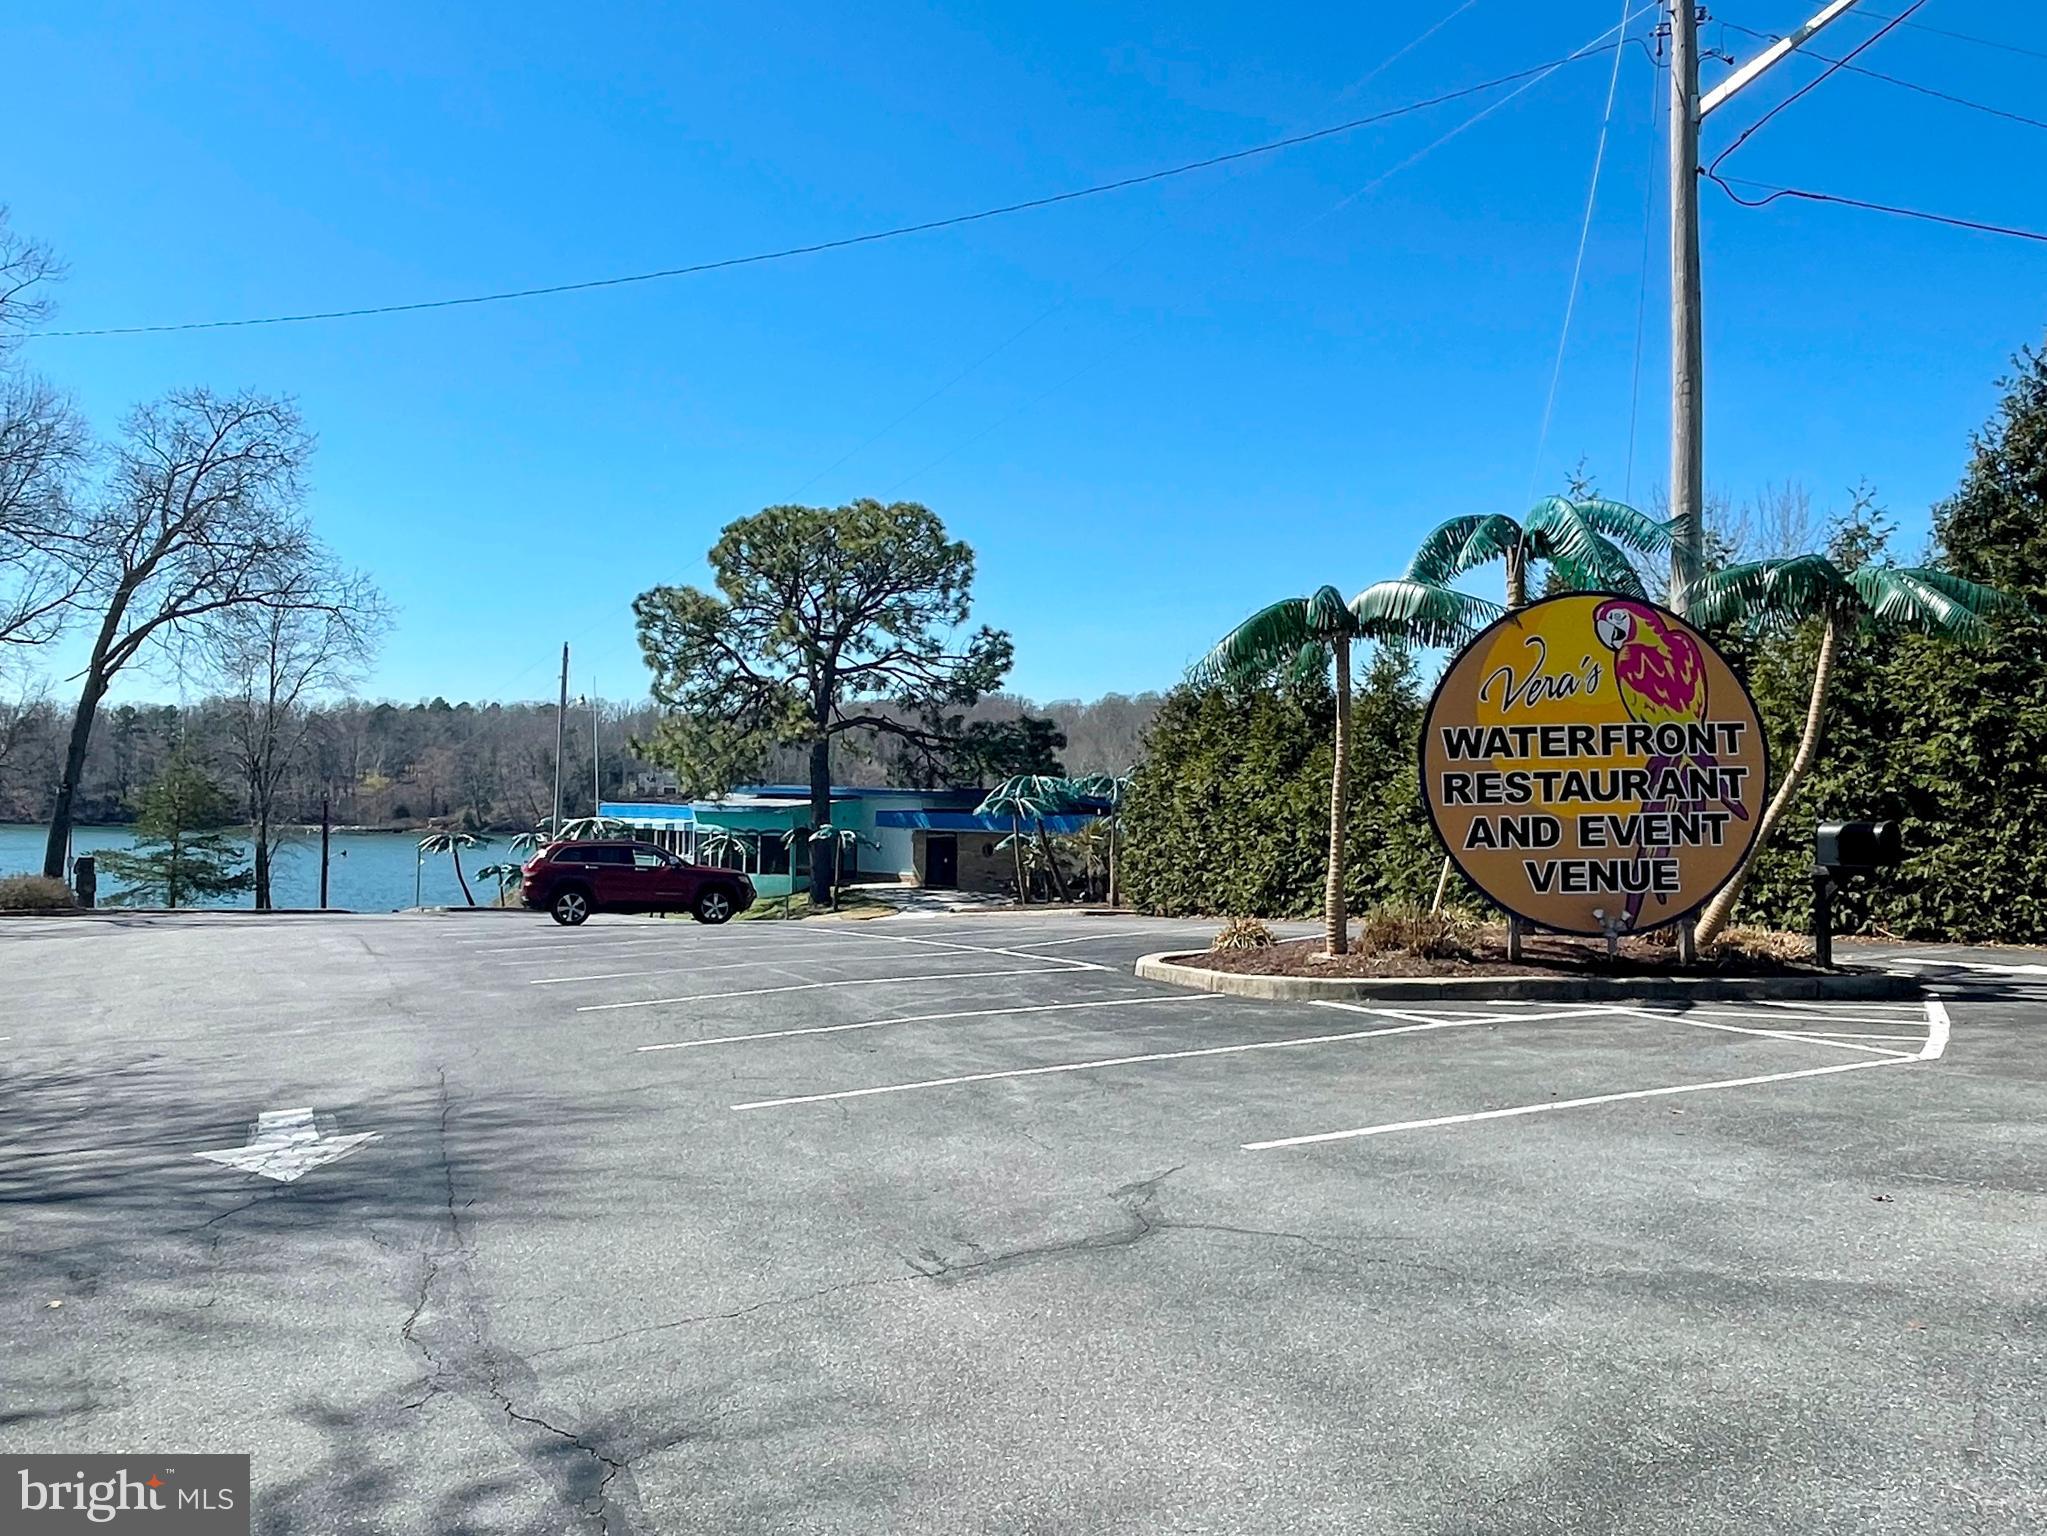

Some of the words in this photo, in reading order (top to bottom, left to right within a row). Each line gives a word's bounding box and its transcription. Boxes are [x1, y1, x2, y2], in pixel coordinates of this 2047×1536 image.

[1480, 636, 1603, 713] Vera's
[1441, 721, 1747, 761] WATERFRONT
[1441, 767, 1748, 806] RESTAURANT
[1465, 815, 1561, 850] AND
[1577, 811, 1730, 849] EVENT
[1524, 857, 1681, 894] VENUE
